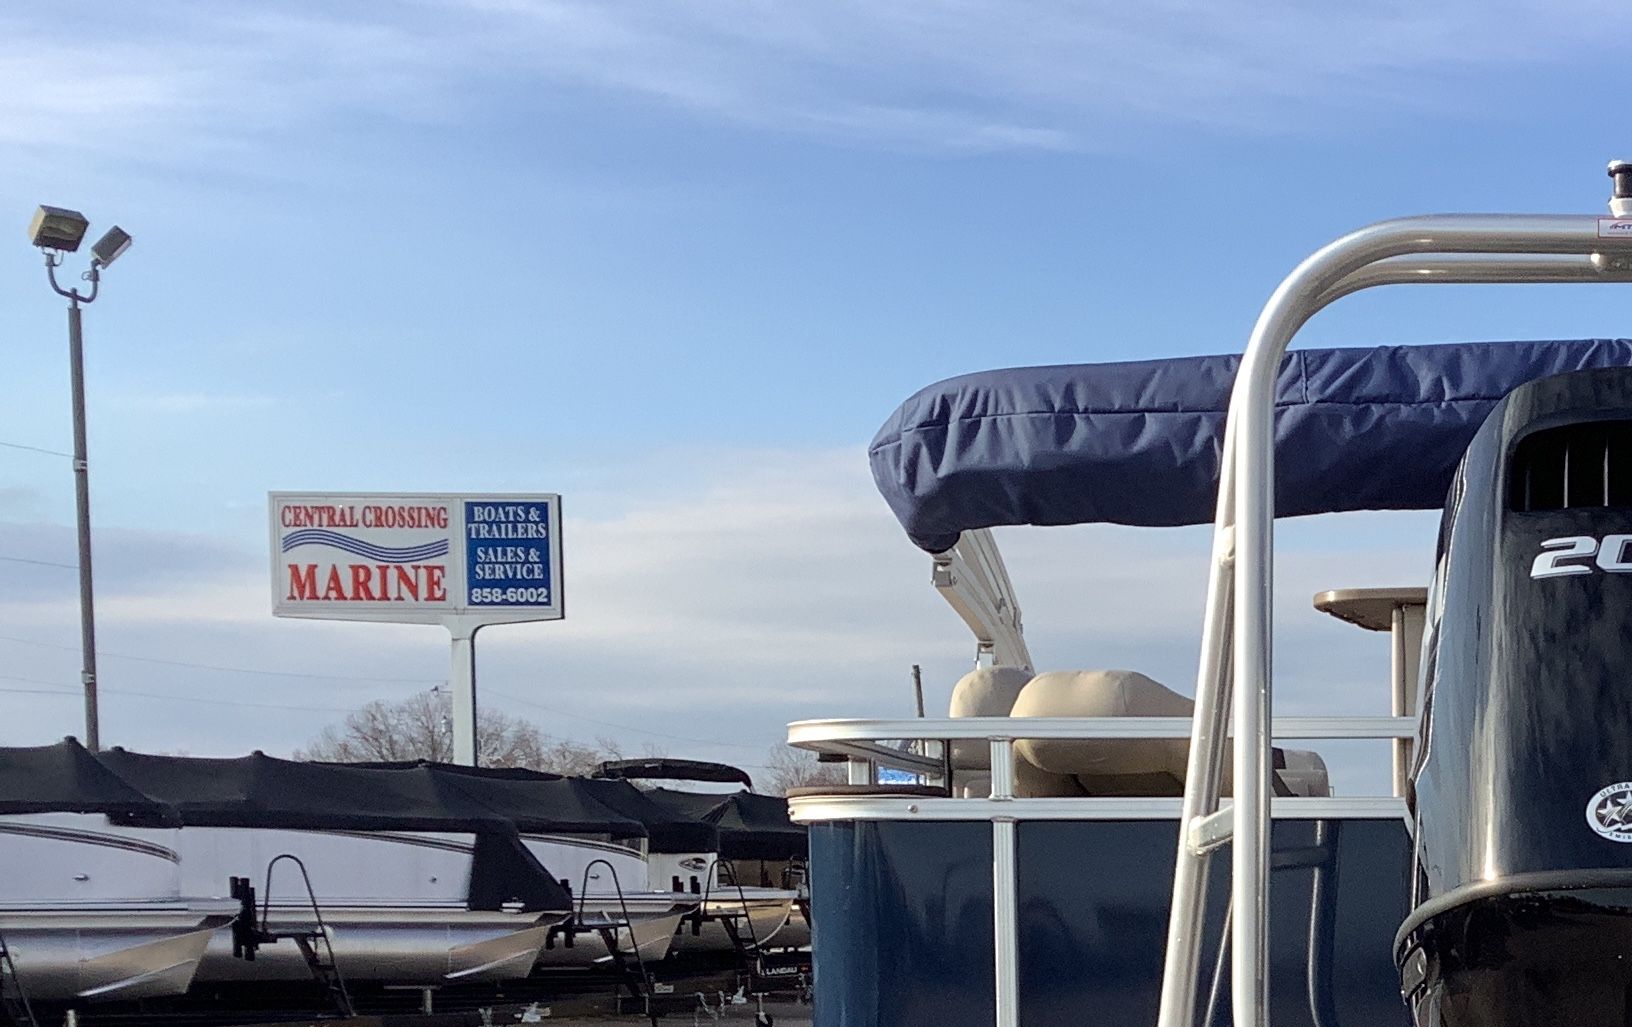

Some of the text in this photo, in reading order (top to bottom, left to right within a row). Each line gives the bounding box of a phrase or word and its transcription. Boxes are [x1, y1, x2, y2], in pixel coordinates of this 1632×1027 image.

[281, 505, 448, 529] CENTRAL CROSSING
[473, 506, 540, 522] BOATS &
[467, 523, 546, 539] TRAILERS
[477, 547, 540, 563] SALES &
[475, 564, 544, 580] SERVICE
[286, 563, 447, 602] MARINE
[471, 588, 548, 603] 858-6002
